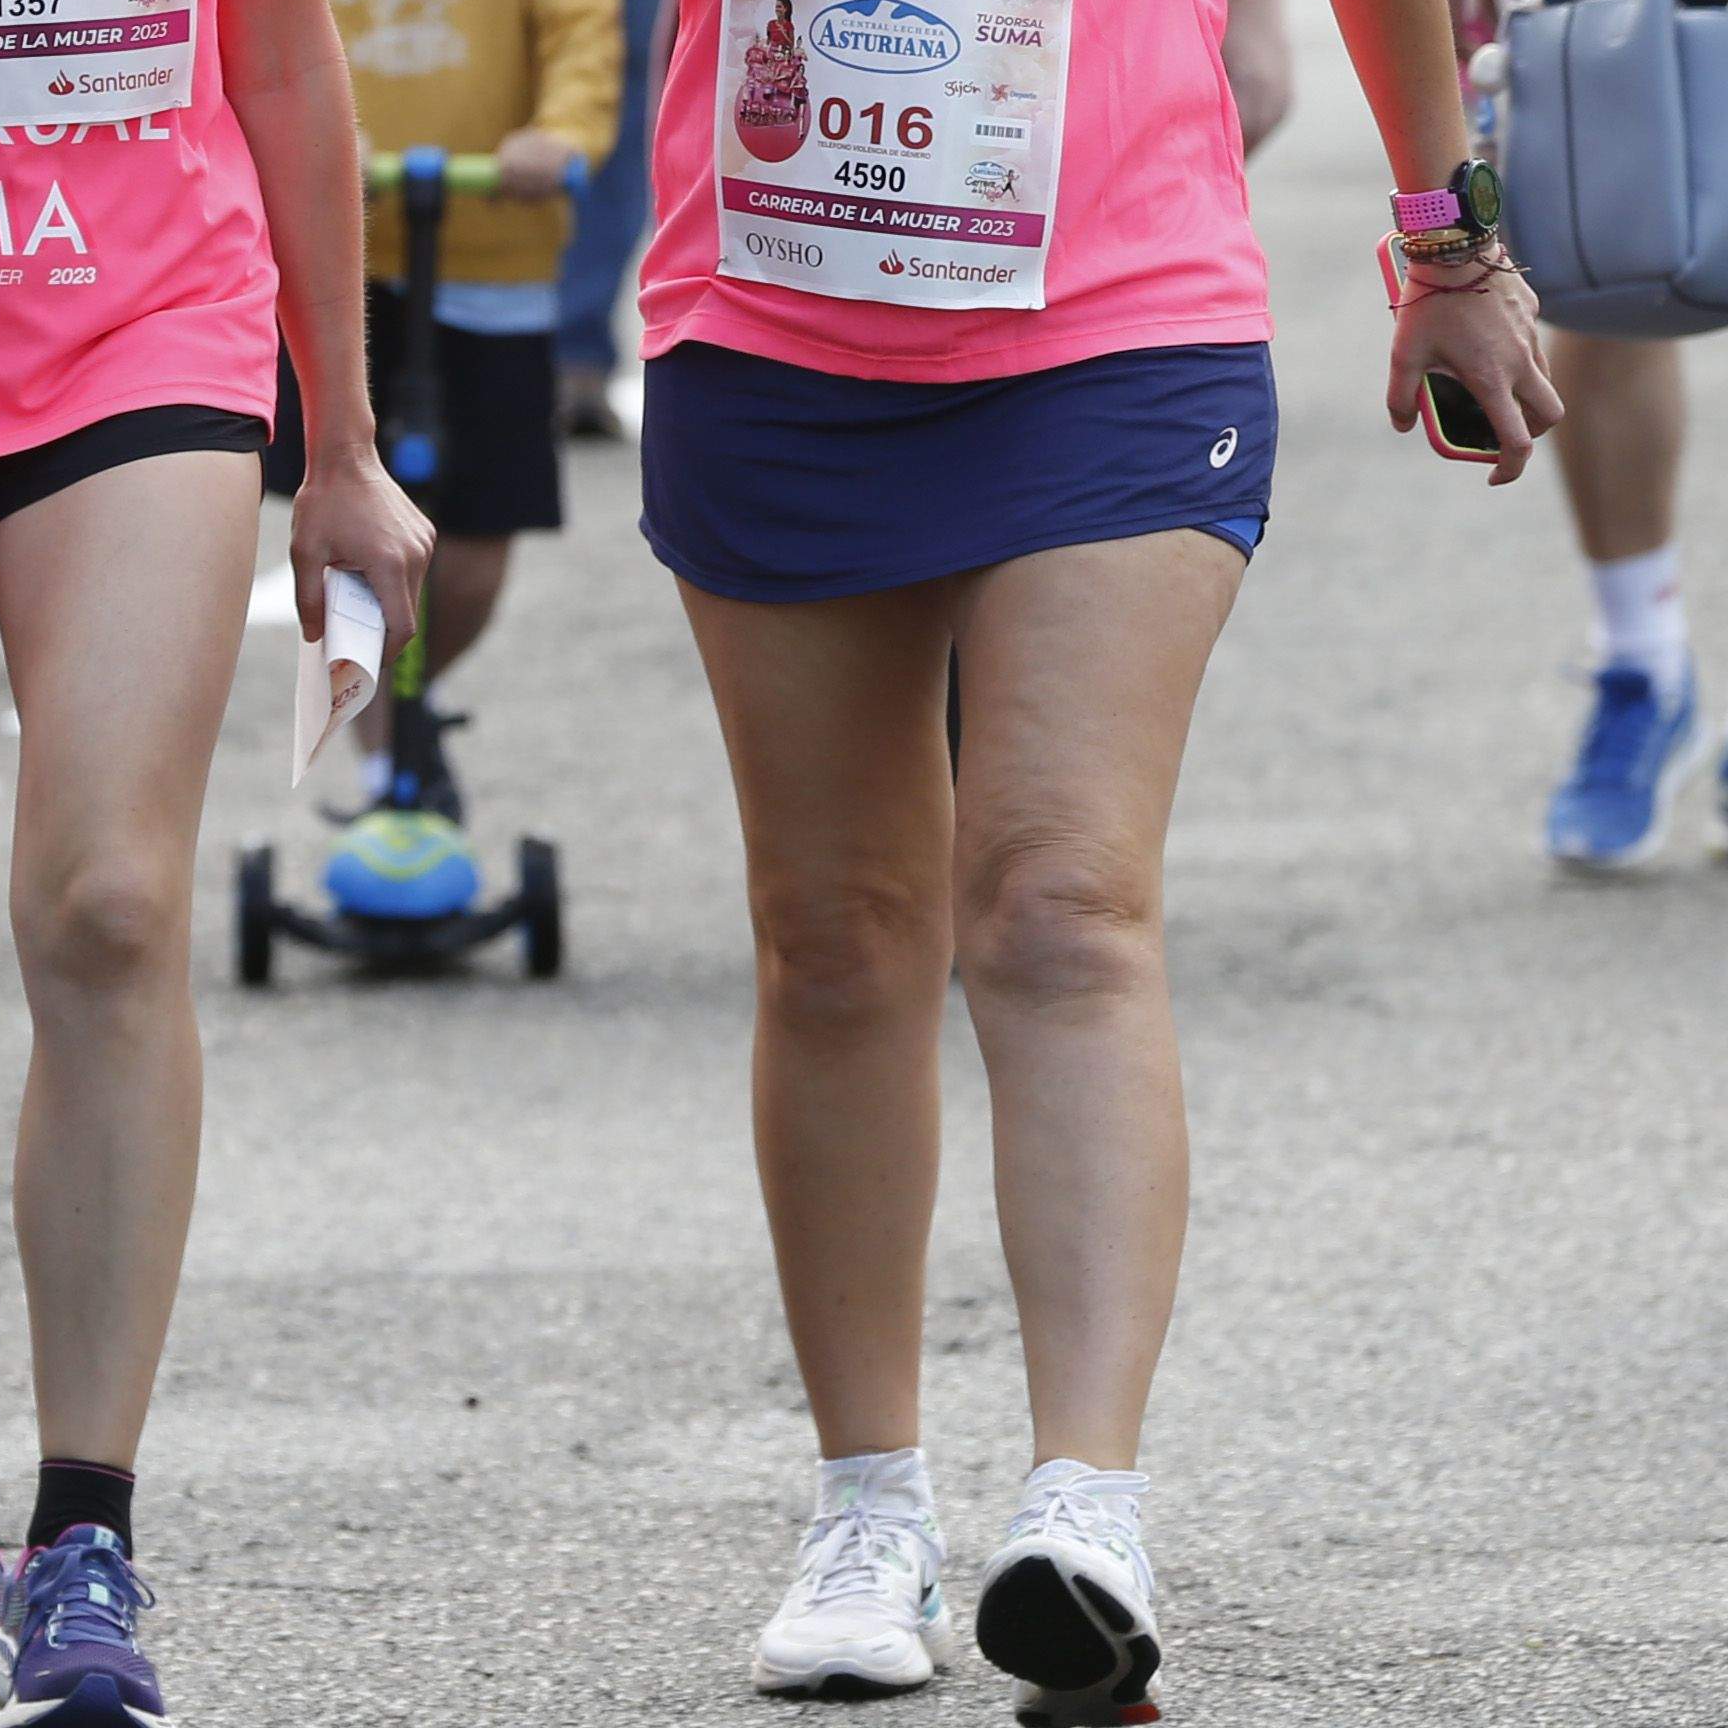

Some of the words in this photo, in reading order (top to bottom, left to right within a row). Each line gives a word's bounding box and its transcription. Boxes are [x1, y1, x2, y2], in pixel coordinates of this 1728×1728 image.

[841, 18, 889, 31] CENTRAL
[893, 24, 945, 36] LECHERA
[976, 14, 992, 24] TU
[995, 15, 1045, 29] DORSAL
[22, 32, 48, 48] LA
[53, 28, 122, 47] MUJER
[130, 22, 168, 41] 2023
[818, 19, 948, 59] ASTURIANA
[975, 25, 1042, 47] SUMA
[79, 68, 175, 94] Santander
[819, 97, 933, 149] 016
[834, 160, 906, 192] 4590
[748, 191, 825, 218] CARRERA
[830, 204, 856, 221] DE
[860, 208, 885, 224] LA
[890, 212, 962, 232] MUJER
[968, 218, 1015, 237] 2023
[746, 232, 823, 268] OYSHO
[48, 266, 96, 285] 2023
[908, 257, 1017, 284] Santander
